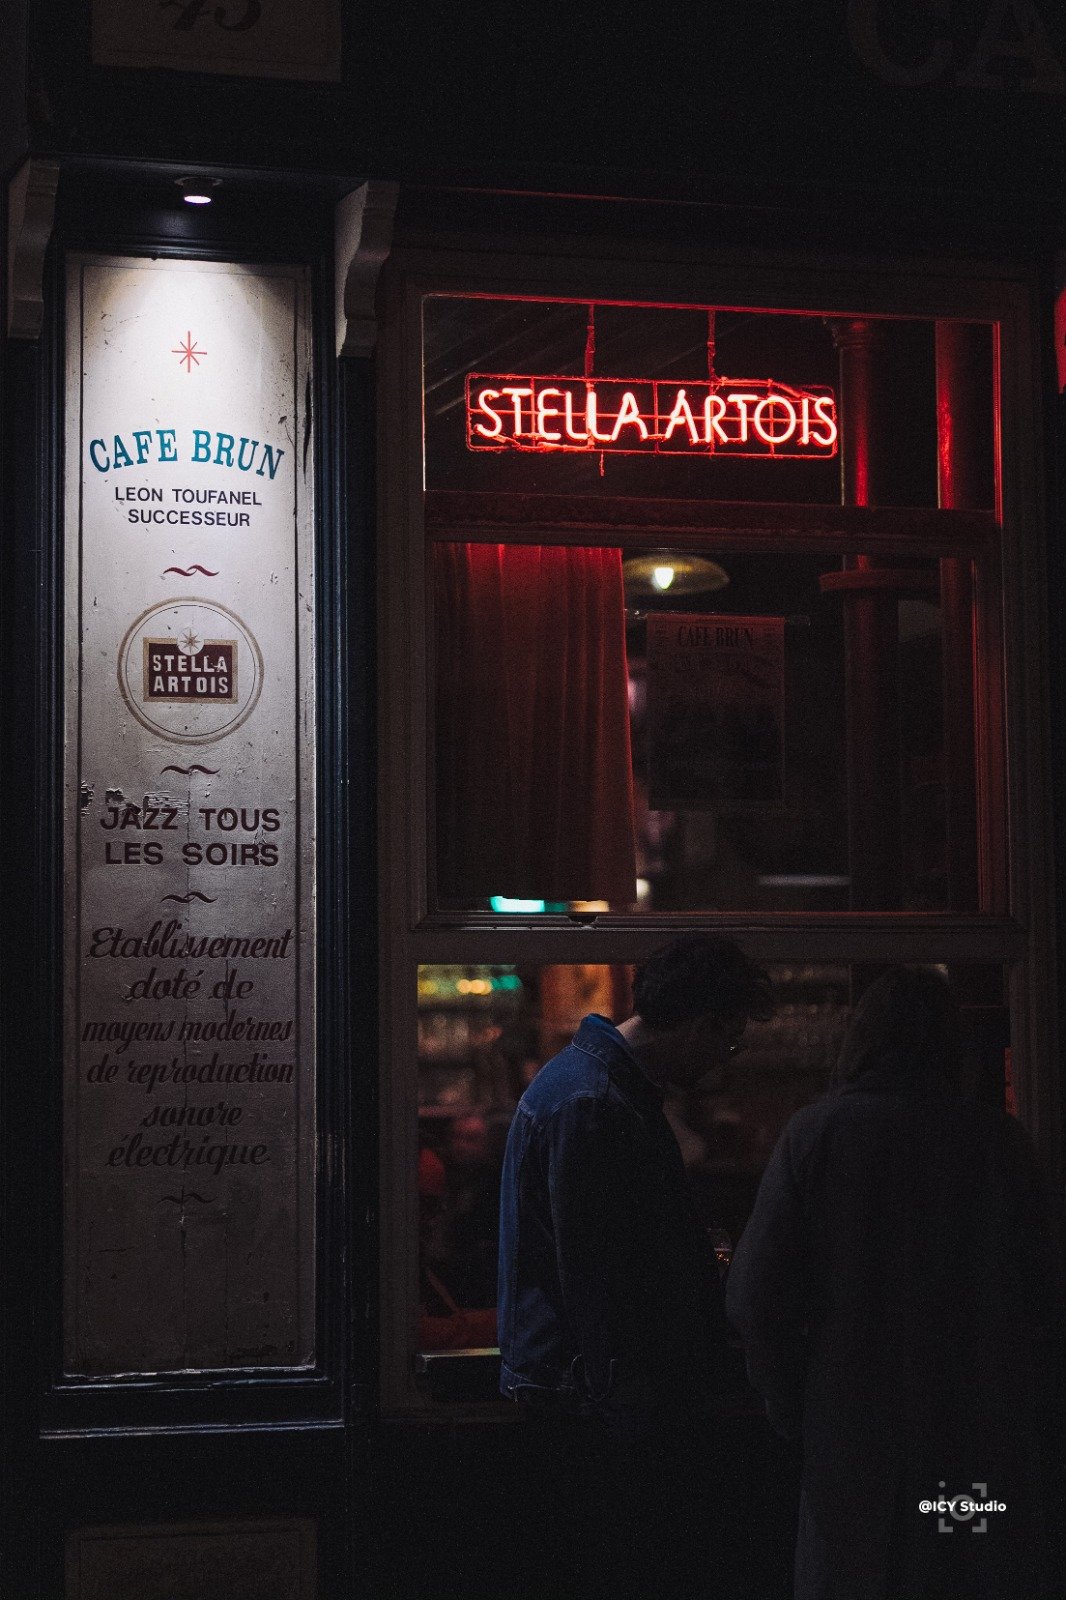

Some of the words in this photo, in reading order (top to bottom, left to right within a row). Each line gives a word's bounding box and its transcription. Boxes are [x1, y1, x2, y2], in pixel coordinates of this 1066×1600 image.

[477, 388, 649, 442] STELLA
[664, 389, 838, 445] ARTOIS
[89, 429, 178, 473] CAFE
[191, 429, 285, 480] BRUN
[115, 486, 163, 502] LEON
[172, 488, 262, 506] TOUFANEL
[128, 509, 250, 527] SUCCESSEUR
[153, 654, 228, 673] STELLA
[153, 676, 229, 694] ARTOIS
[100, 805, 179, 830] JAZZ
[198, 807, 281, 832] TOUS
[105, 841, 164, 865] LES
[181, 842, 279, 867] SOIRS
[85, 919, 293, 959] Etablissement
[124, 967, 205, 1000] doté
[208, 968, 254, 1000] de
[82, 1019, 176, 1055] moyens
[177, 1008, 293, 1042] modernes
[86, 1053, 119, 1084] de
[127, 1052, 294, 1094] reproduction
[139, 1101, 243, 1128] sonore
[104, 1132, 271, 1175] électrique
